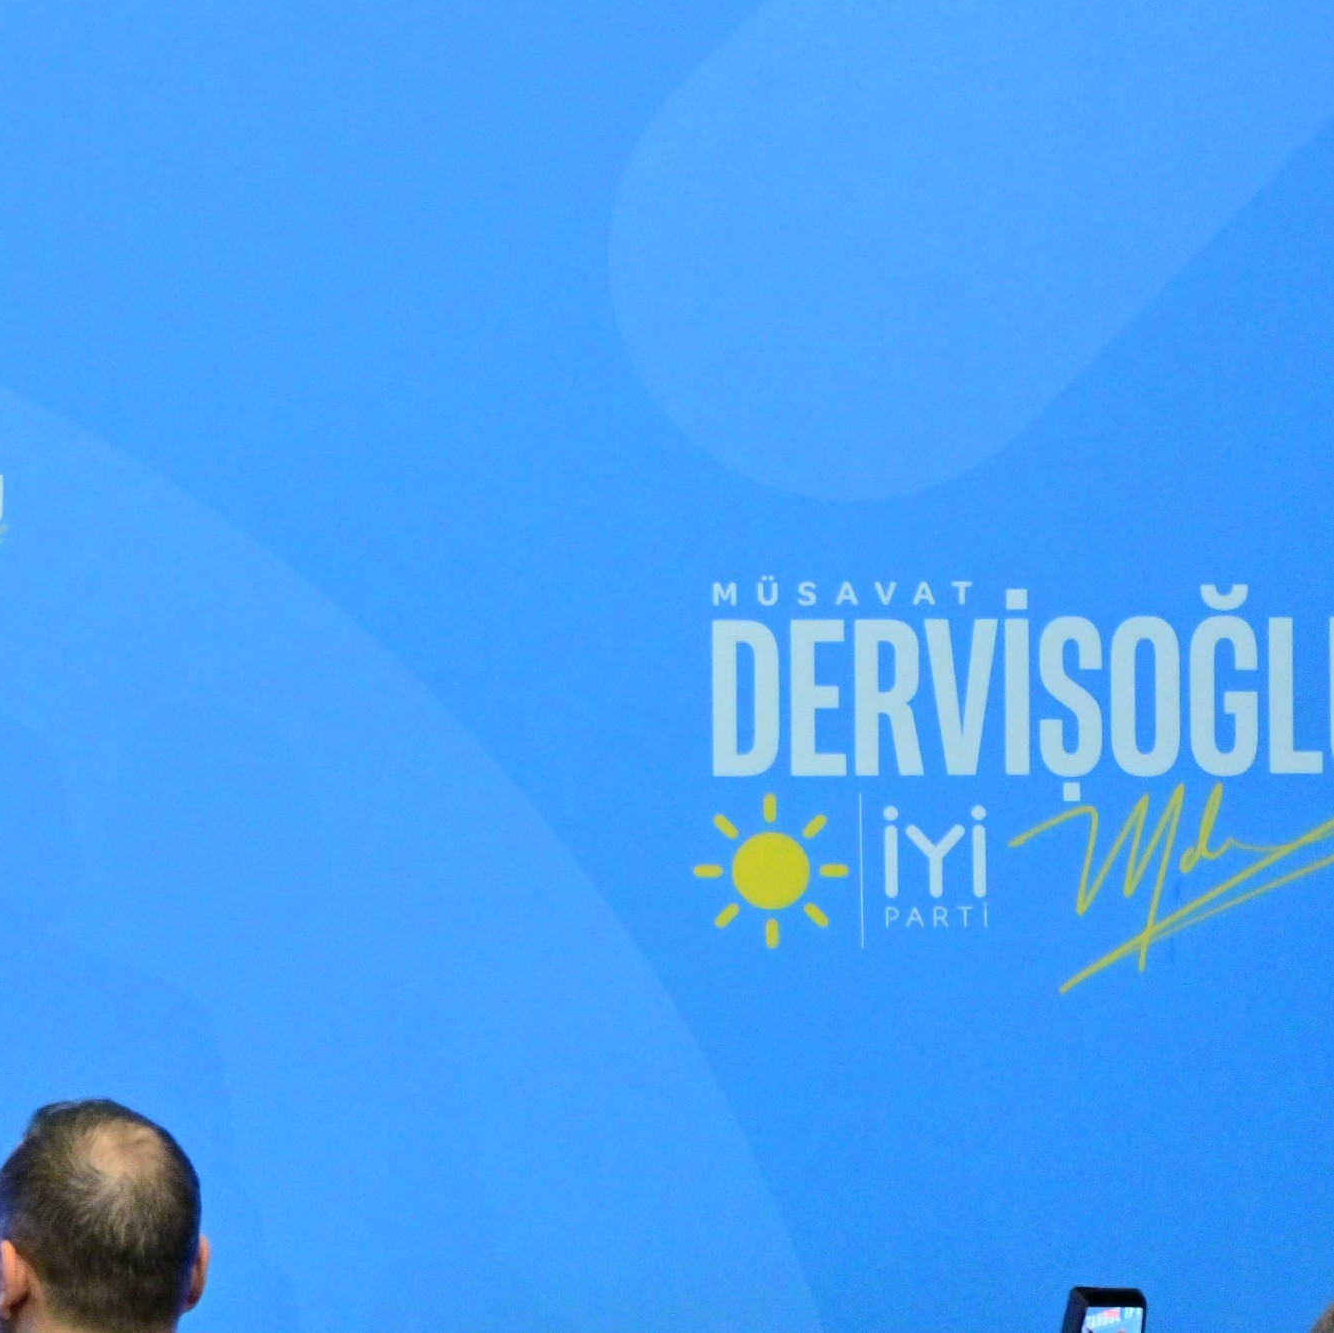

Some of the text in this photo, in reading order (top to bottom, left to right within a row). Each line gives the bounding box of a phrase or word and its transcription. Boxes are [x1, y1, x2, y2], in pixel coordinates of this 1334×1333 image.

[712, 575, 973, 606] MÜSAVAT
[712, 584, 1334, 802] DERVİŞOĞL
[883, 805, 987, 898] İYİ
[884, 902, 988, 928] PARTİ
